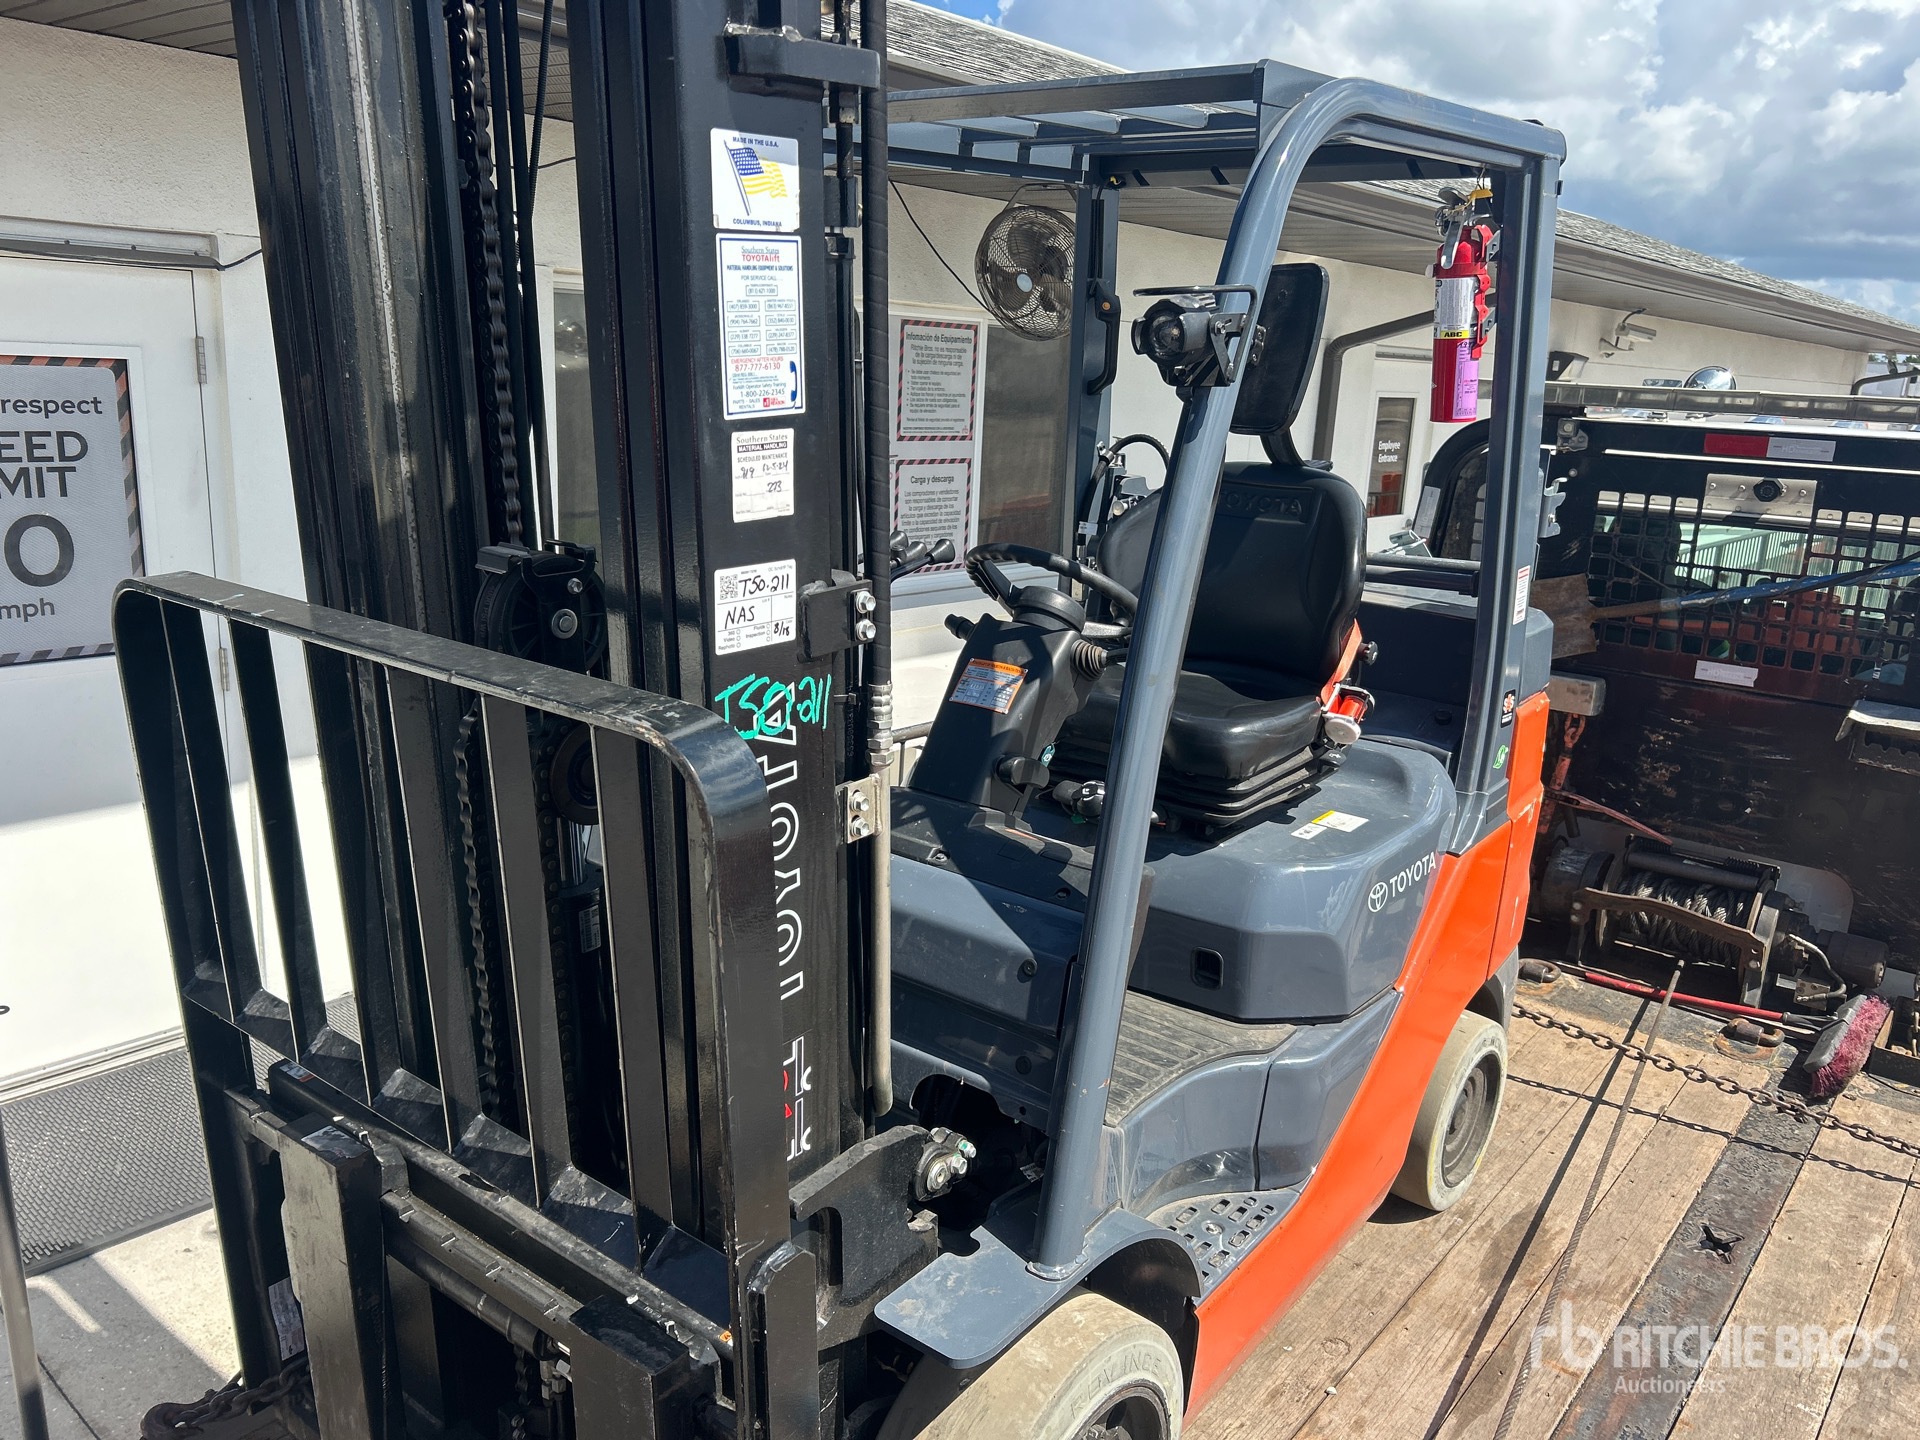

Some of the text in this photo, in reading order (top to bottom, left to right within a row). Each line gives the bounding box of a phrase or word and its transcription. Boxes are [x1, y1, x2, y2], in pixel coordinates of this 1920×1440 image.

[733, 218, 761, 226] COLUMBUS,
[741, 246, 764, 254] Southern
[941, 334, 972, 345] Equipamiento
[735, 362, 781, 372] 877-777-6130
[740, 388, 785, 398] 1-800-226-2345
[1, 397, 102, 419] respect
[736, 436, 768, 444] Southern
[738, 442, 786, 452] MATERIAL HANDLING
[1379, 440, 1400, 452] Employee
[737, 455, 761, 463] SCHEDULED
[1378, 454, 1398, 462] Entrance
[910, 475, 954, 485] Carga y descarga
[0, 597, 55, 623] mph
[725, 606, 755, 629] NAS
[1390, 852, 1436, 897] TOYOTA
